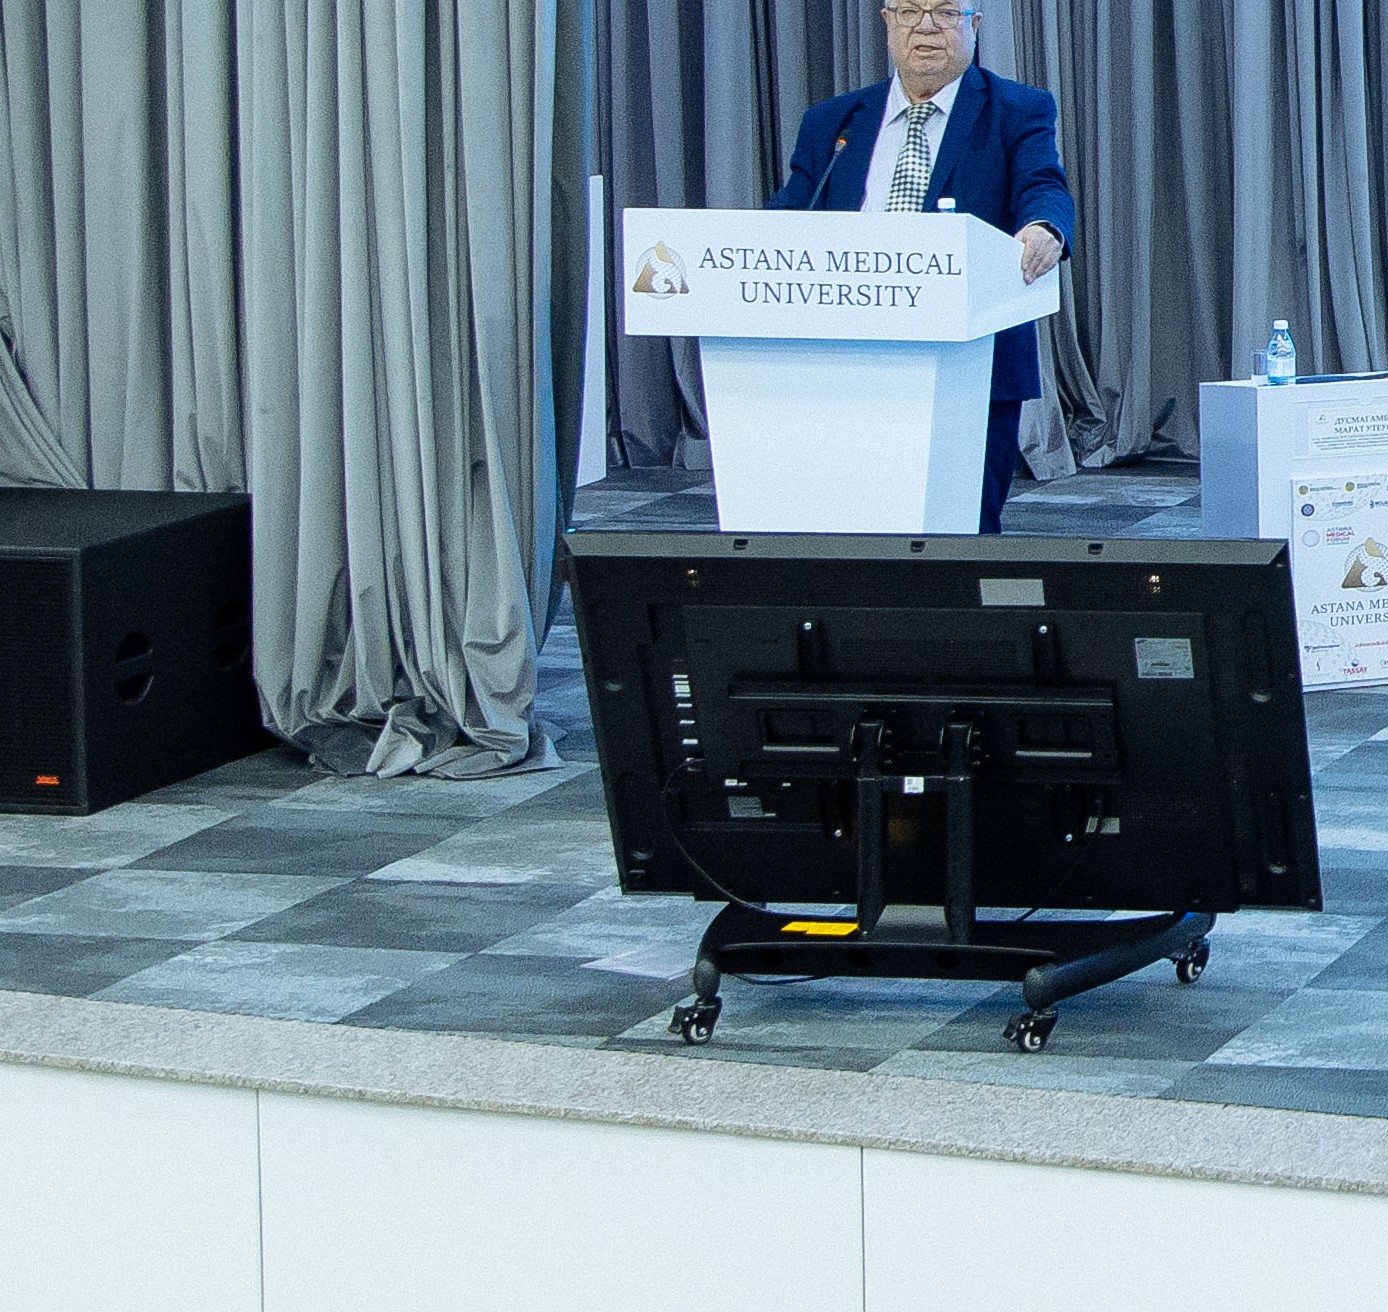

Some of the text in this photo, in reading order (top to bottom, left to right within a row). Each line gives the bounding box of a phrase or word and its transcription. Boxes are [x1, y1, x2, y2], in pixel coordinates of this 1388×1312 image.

[699, 247, 961, 275] ASTANA MEDICAL
[740, 282, 921, 307] UNIVERSITY
[1311, 600, 1364, 614] ASTANA
